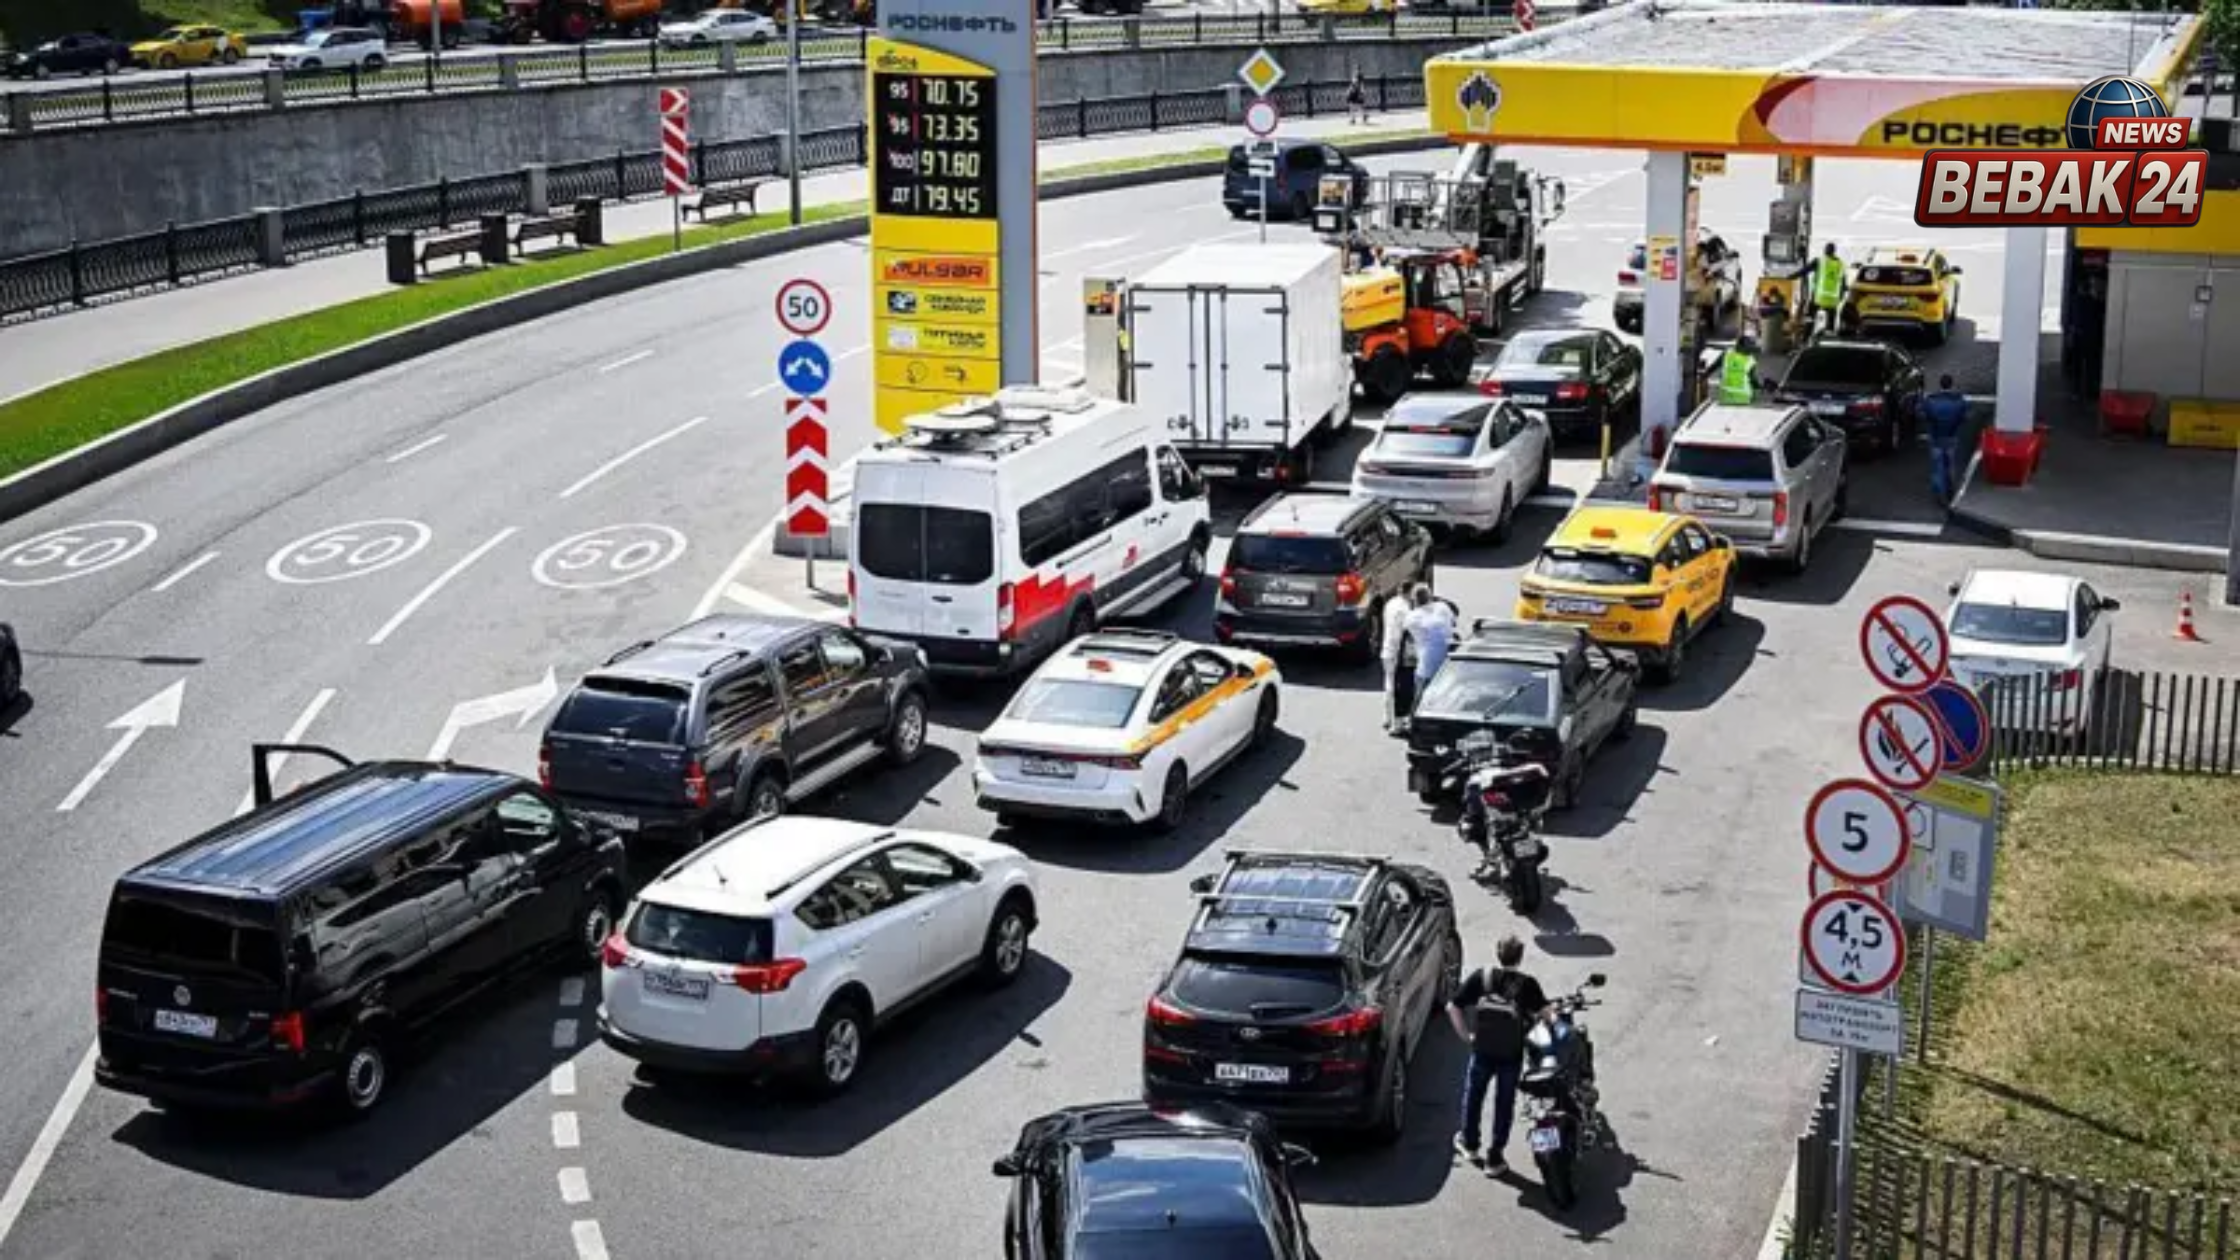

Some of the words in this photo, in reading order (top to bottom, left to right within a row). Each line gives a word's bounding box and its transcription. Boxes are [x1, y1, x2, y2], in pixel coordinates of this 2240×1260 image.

[887, 14, 1017, 33] РОСНЕФТЬ
[889, 81, 909, 99] 95
[921, 78, 979, 107] 70.75
[922, 114, 979, 141] 73.35
[1883, 122, 2065, 148] РОСНЕФ
[923, 185, 980, 213] 79.45
[788, 295, 819, 318] 50
[14, 536, 128, 567] 50
[295, 534, 404, 566] 50
[557, 539, 660, 571] 50
[1841, 810, 1869, 853] 5
[1824, 909, 1883, 949] 4,5
